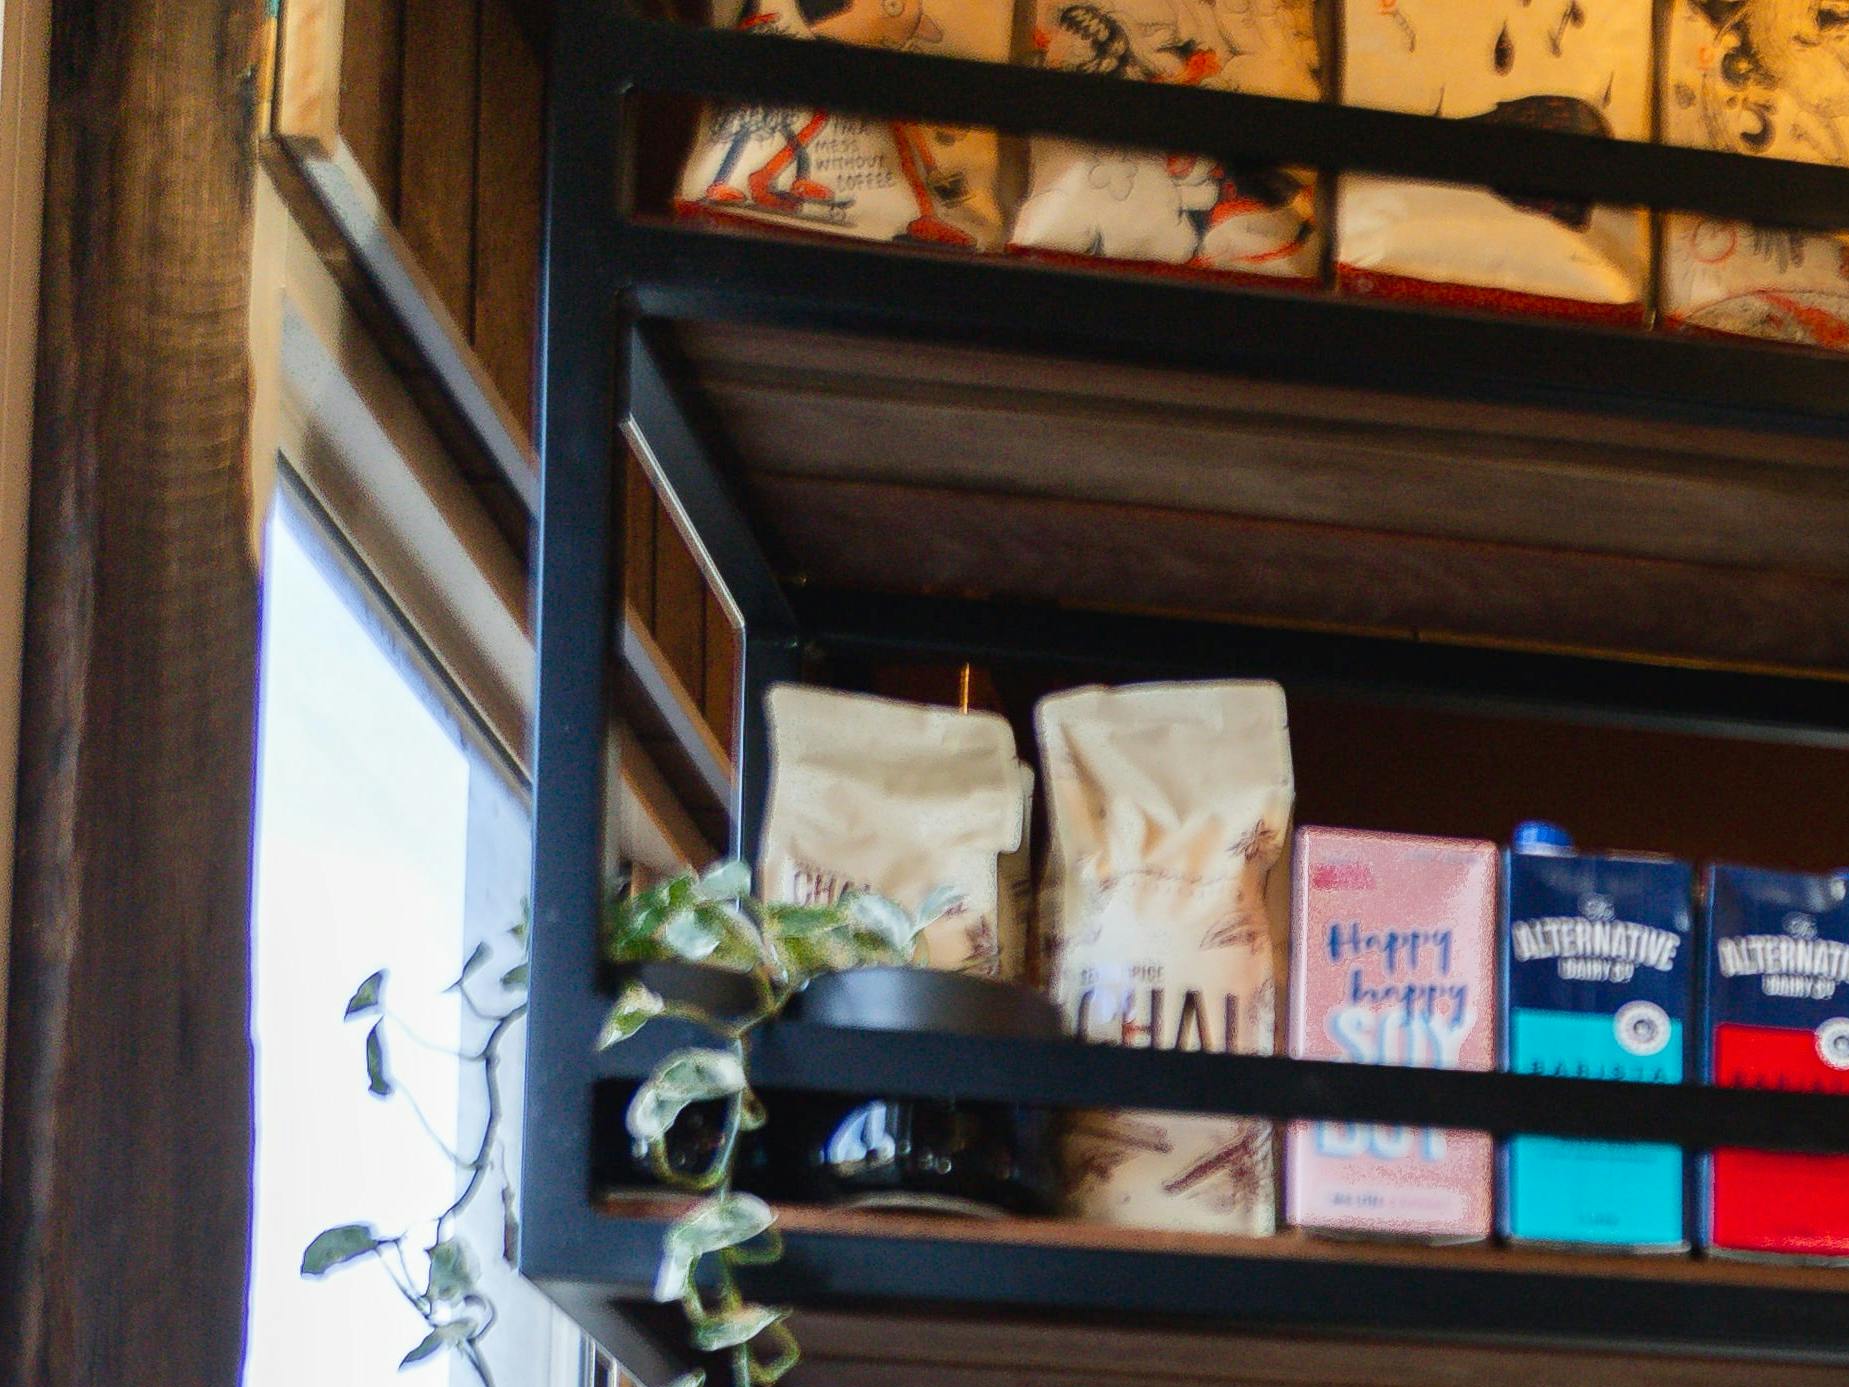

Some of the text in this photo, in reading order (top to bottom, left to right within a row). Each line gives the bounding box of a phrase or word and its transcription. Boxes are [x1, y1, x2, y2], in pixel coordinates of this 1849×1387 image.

[1327, 922, 1452, 976] Happy
[1512, 915, 1681, 973] ALTERNATIVE
[1351, 969, 1469, 1028] happy
